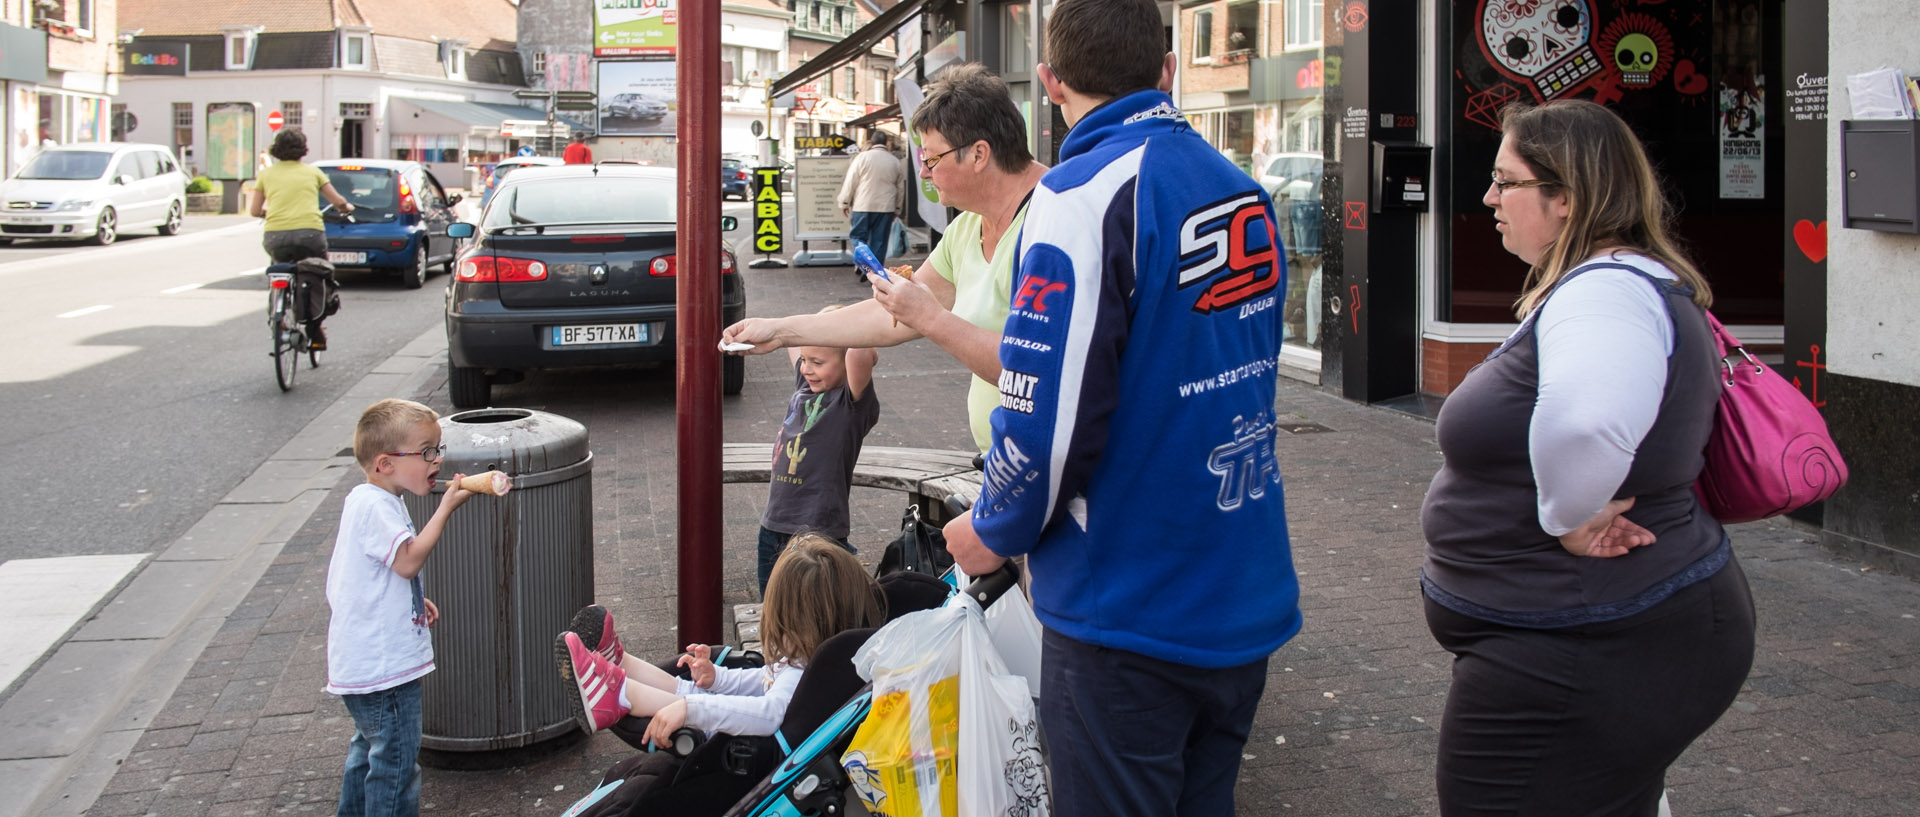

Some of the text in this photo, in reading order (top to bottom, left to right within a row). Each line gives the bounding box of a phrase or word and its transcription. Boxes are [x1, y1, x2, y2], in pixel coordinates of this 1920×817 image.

[1796, 73, 1828, 88] Ouver
[1397, 116, 1415, 127] 223
[797, 137, 844, 149] TABAC
[757, 170, 780, 251] TABAC
[570, 289, 630, 297] LAGUNA
[1022, 311, 1050, 323] PARTS
[1003, 336, 1052, 352] DUNLOP
[776, 473, 803, 485] CACTUS
